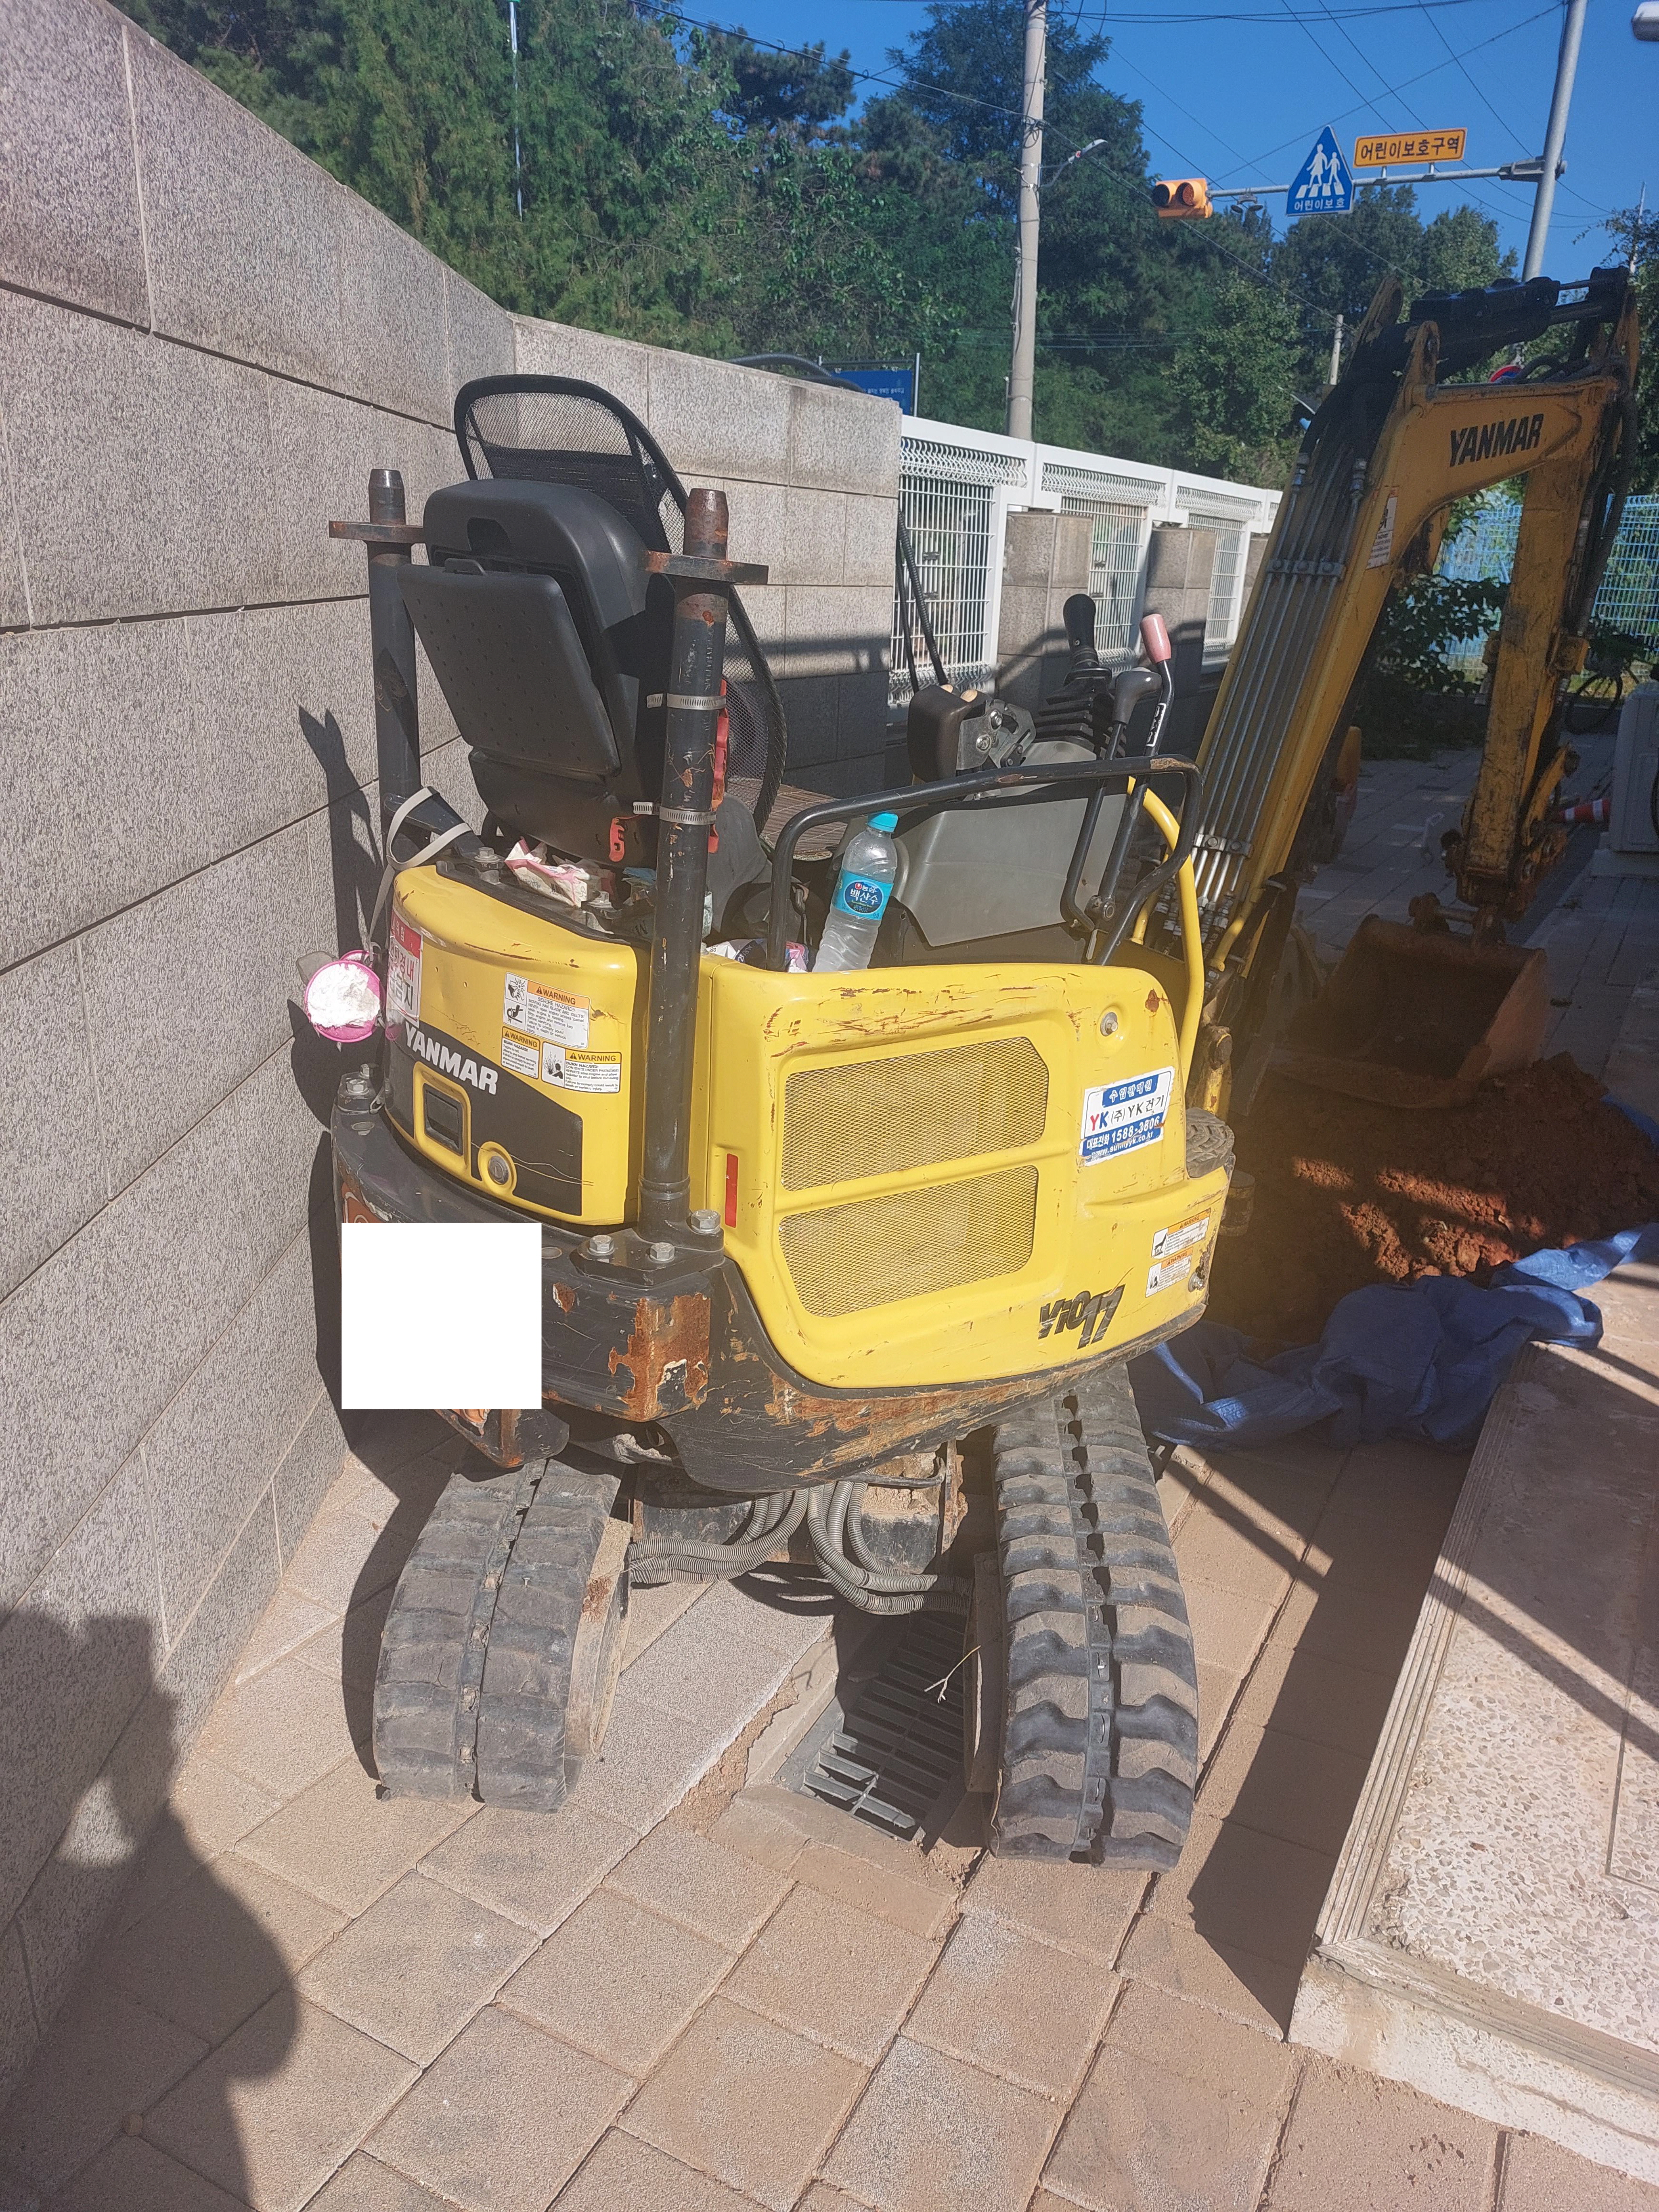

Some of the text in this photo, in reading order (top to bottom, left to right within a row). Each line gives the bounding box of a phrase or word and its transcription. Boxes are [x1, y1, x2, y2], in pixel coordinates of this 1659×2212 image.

[1360, 136, 1460, 161] 어린이보호구역
[1294, 198, 1345, 211] 어린이보호
[1449, 413, 1544, 467] YANMAR
[850, 888, 878, 905] 백산수
[538, 997, 553, 1005] SEVERE
[543, 989, 575, 1005] WARNING
[510, 1032, 537, 1048] WARNING
[405, 1021, 499, 1095] YANMAR
[577, 1053, 616, 1062] WARNING
[1109, 1079, 1152, 1103] 수입판매원
[1090, 1111, 1109, 1131] YK
[1086, 1134, 1110, 1150] 대표전화
